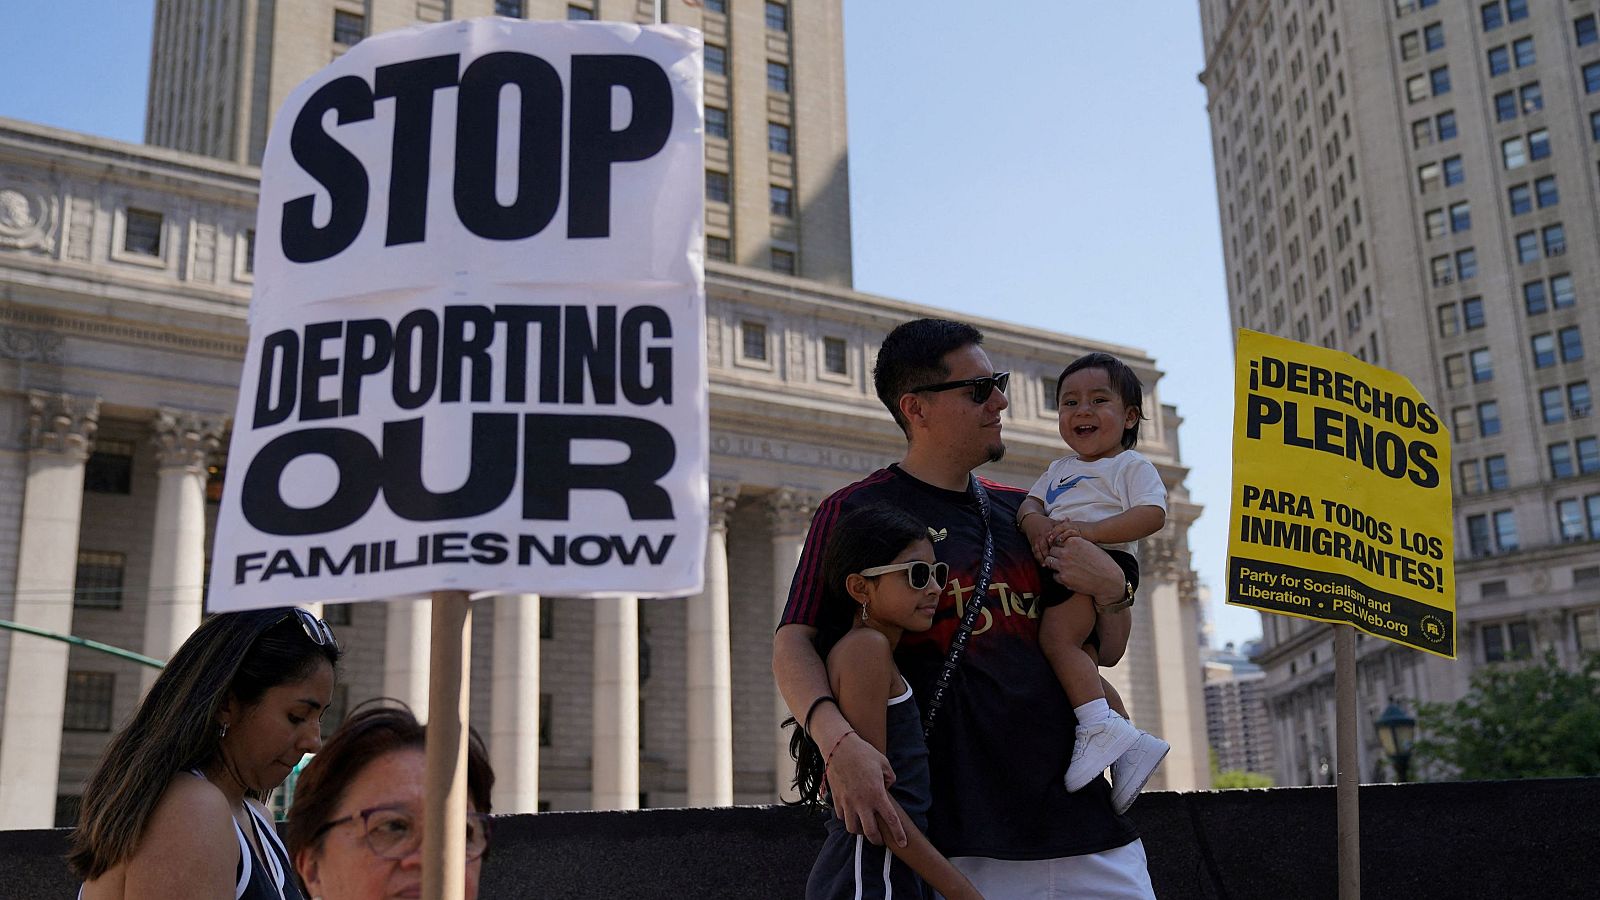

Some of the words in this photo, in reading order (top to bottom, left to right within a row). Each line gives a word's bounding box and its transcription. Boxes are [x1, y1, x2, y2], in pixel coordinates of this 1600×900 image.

[281, 51, 673, 263] STOP
[253, 304, 673, 430] DEPORTING
[1250, 356, 1439, 435] ¡DERECHOS
[241, 412, 676, 536] OUR
[714, 435, 791, 460] OURT
[1246, 393, 1440, 489] PLENOS
[235, 532, 509, 585] FAMILIES
[517, 534, 676, 567] NOW
[1240, 515, 1444, 593] INMIGRANTES!
[1242, 485, 1315, 519] PARA
[1321, 499, 1393, 545] TODOS
[1400, 527, 1444, 561] LOS
[1239, 567, 1278, 587] Party
[1281, 573, 1301, 588] for
[1303, 578, 1366, 605] Socialism
[1367, 598, 1391, 614] and
[1239, 584, 1311, 607] Liberation
[1332, 598, 1408, 638] PSLWeb.org
